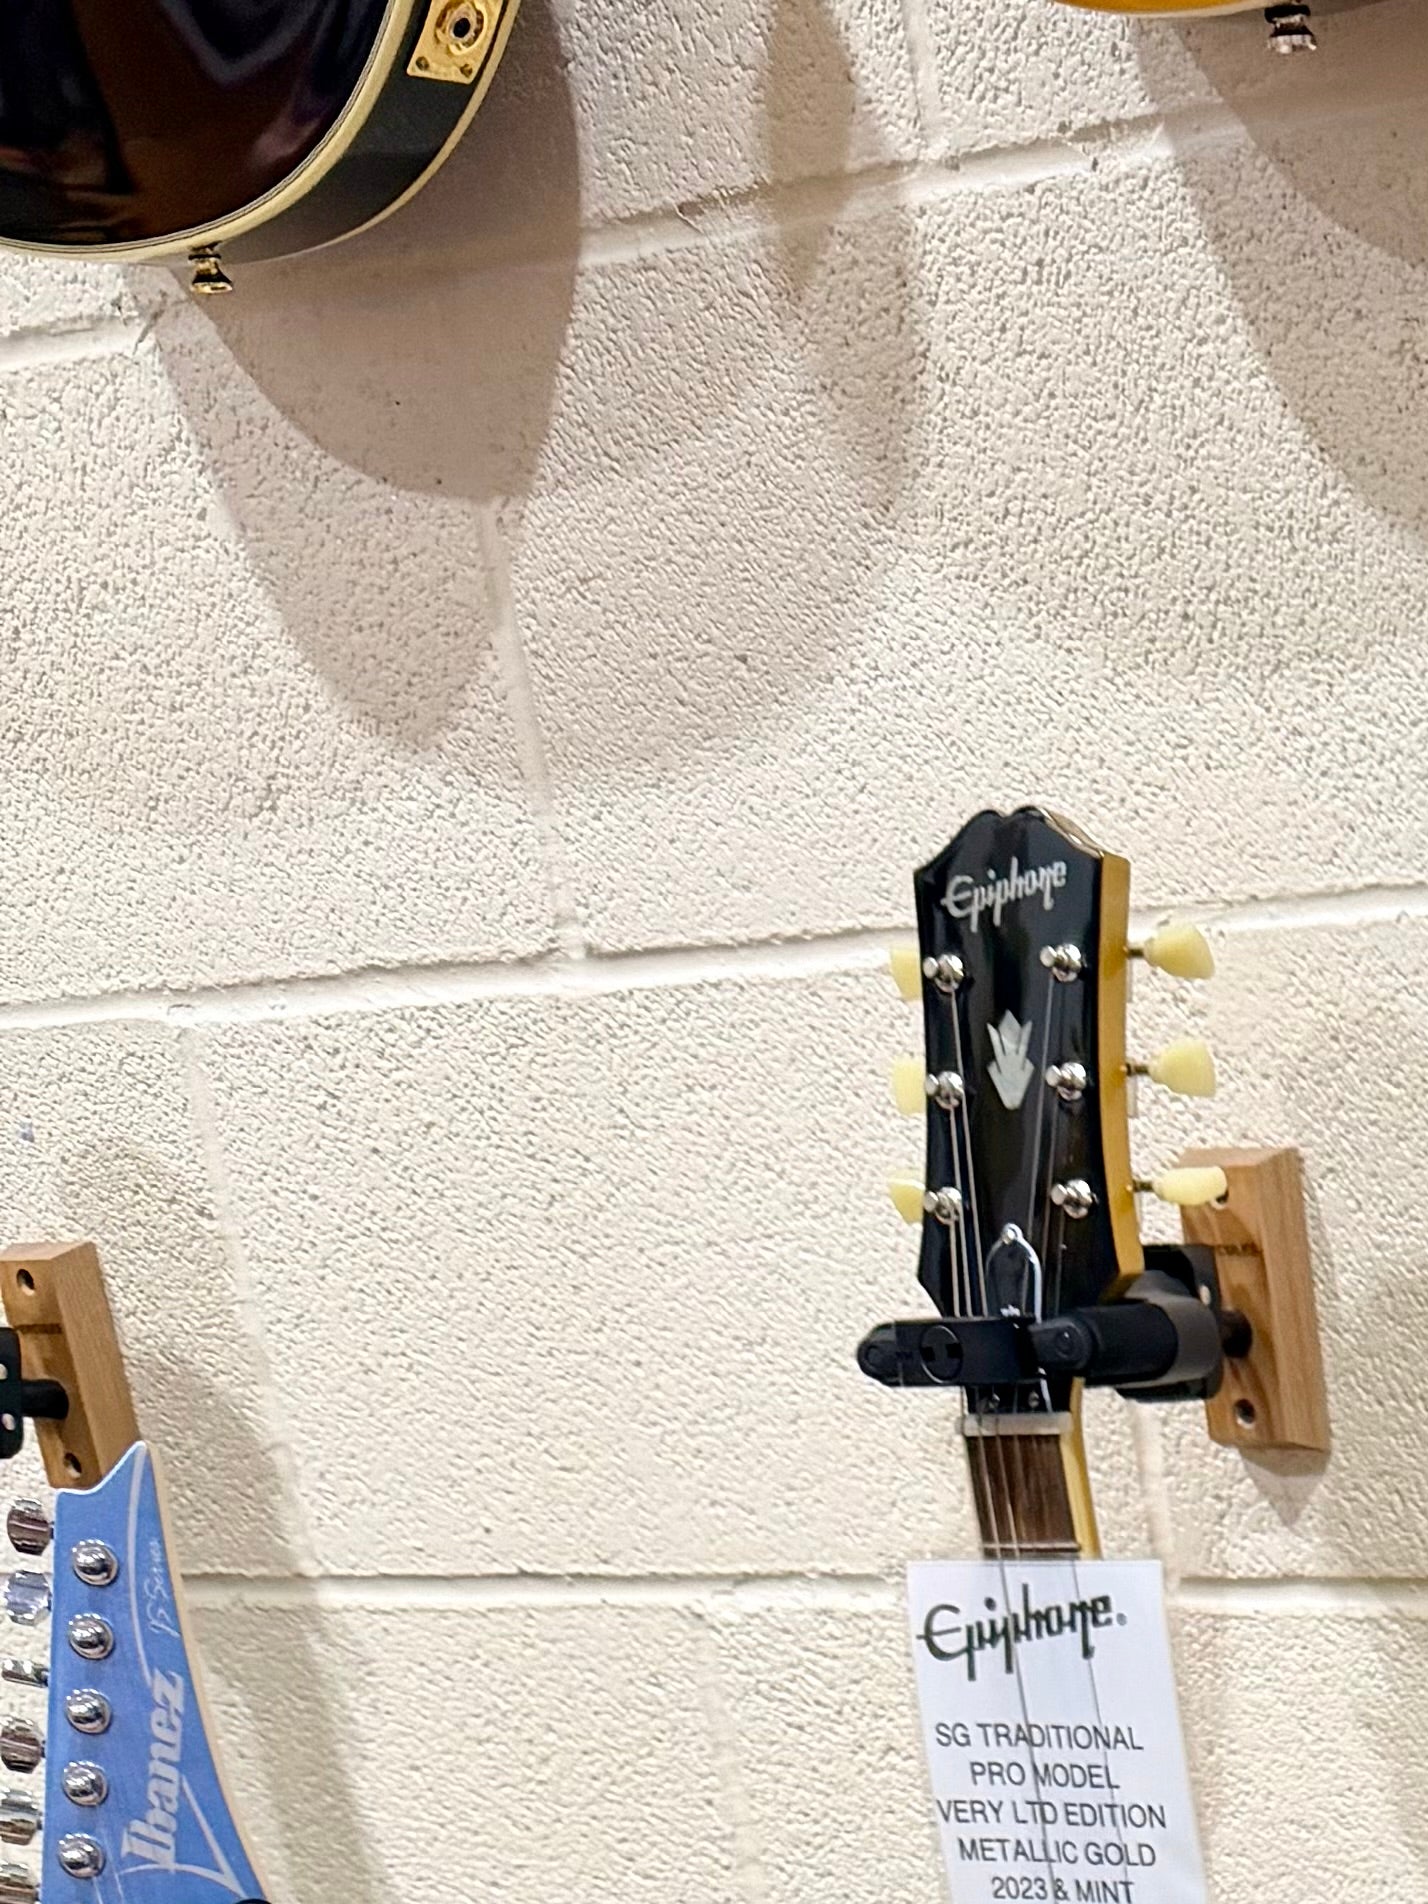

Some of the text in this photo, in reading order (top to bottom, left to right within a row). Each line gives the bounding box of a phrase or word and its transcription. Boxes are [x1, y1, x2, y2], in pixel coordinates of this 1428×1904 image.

[940, 856, 1067, 933] Epiphone
[935, 1722, 1144, 1750] SG TRADITIONAL
[120, 1667, 185, 1874] Ibanez
[970, 1761, 1120, 1789] PRO MODEL
[937, 1800, 1167, 1829] VERY LTD EDITION
[957, 1838, 1156, 1866] METALLIC GOLD
[991, 1876, 1135, 1904] 2023 & MINT
